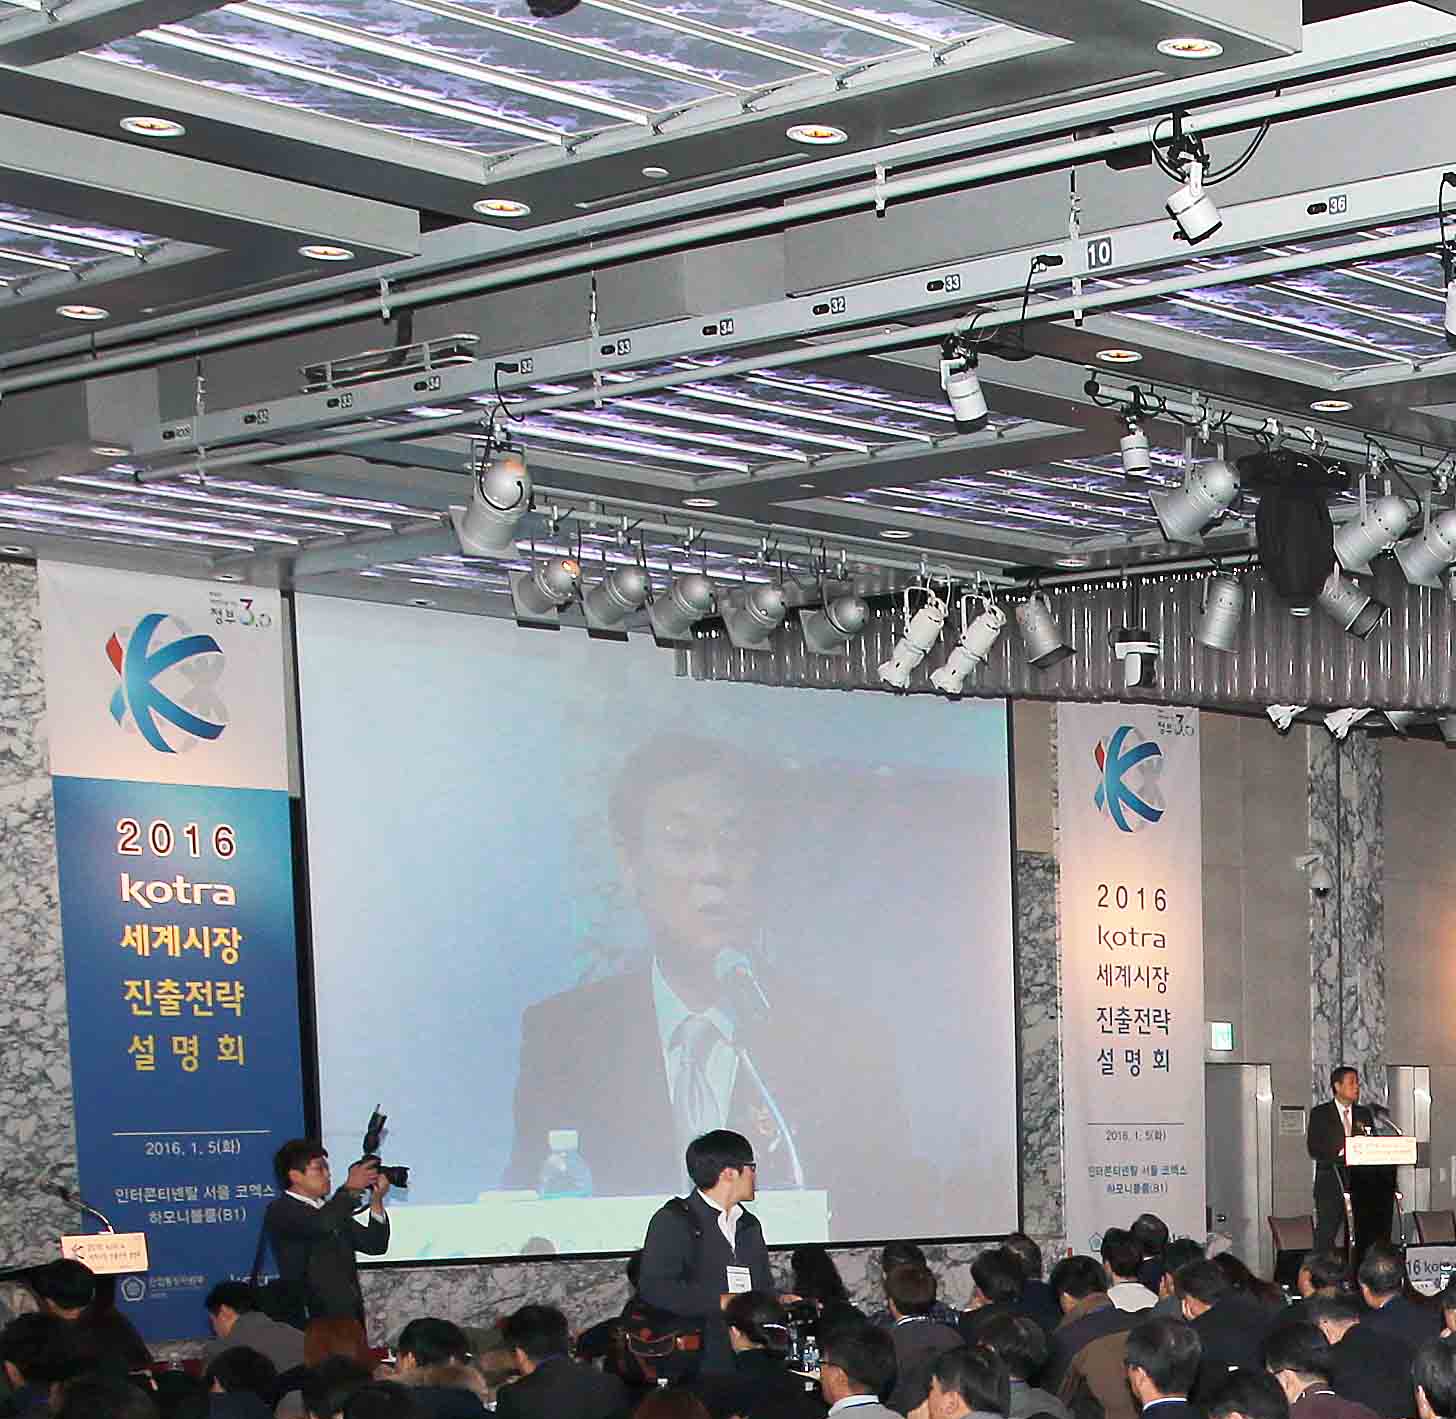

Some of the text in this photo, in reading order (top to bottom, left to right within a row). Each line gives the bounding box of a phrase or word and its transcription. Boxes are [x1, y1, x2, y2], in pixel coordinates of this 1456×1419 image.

[1330, 196, 1346, 213] 36
[1088, 239, 1111, 267] 10
[945, 275, 959, 290] 33
[832, 297, 845, 313] 32
[720, 320, 733, 334] 34
[618, 340, 630, 354] 33
[117, 818, 236, 859] 2016
[120, 872, 236, 908] kotra
[1097, 884, 1166, 912] 2016
[120, 923, 242, 965] 세계시장
[1098, 924, 1166, 951] kotra
[1096, 963, 1169, 994] 세계시장
[123, 979, 245, 1017] 진출전략
[1097, 1006, 1171, 1036] 진출전략
[145, 1141, 185, 1156] 2016.
[208, 1138, 241, 1154] 5(화)
[203, 1186, 230, 1200] 서울
[235, 1184, 276, 1199] 코엑스
